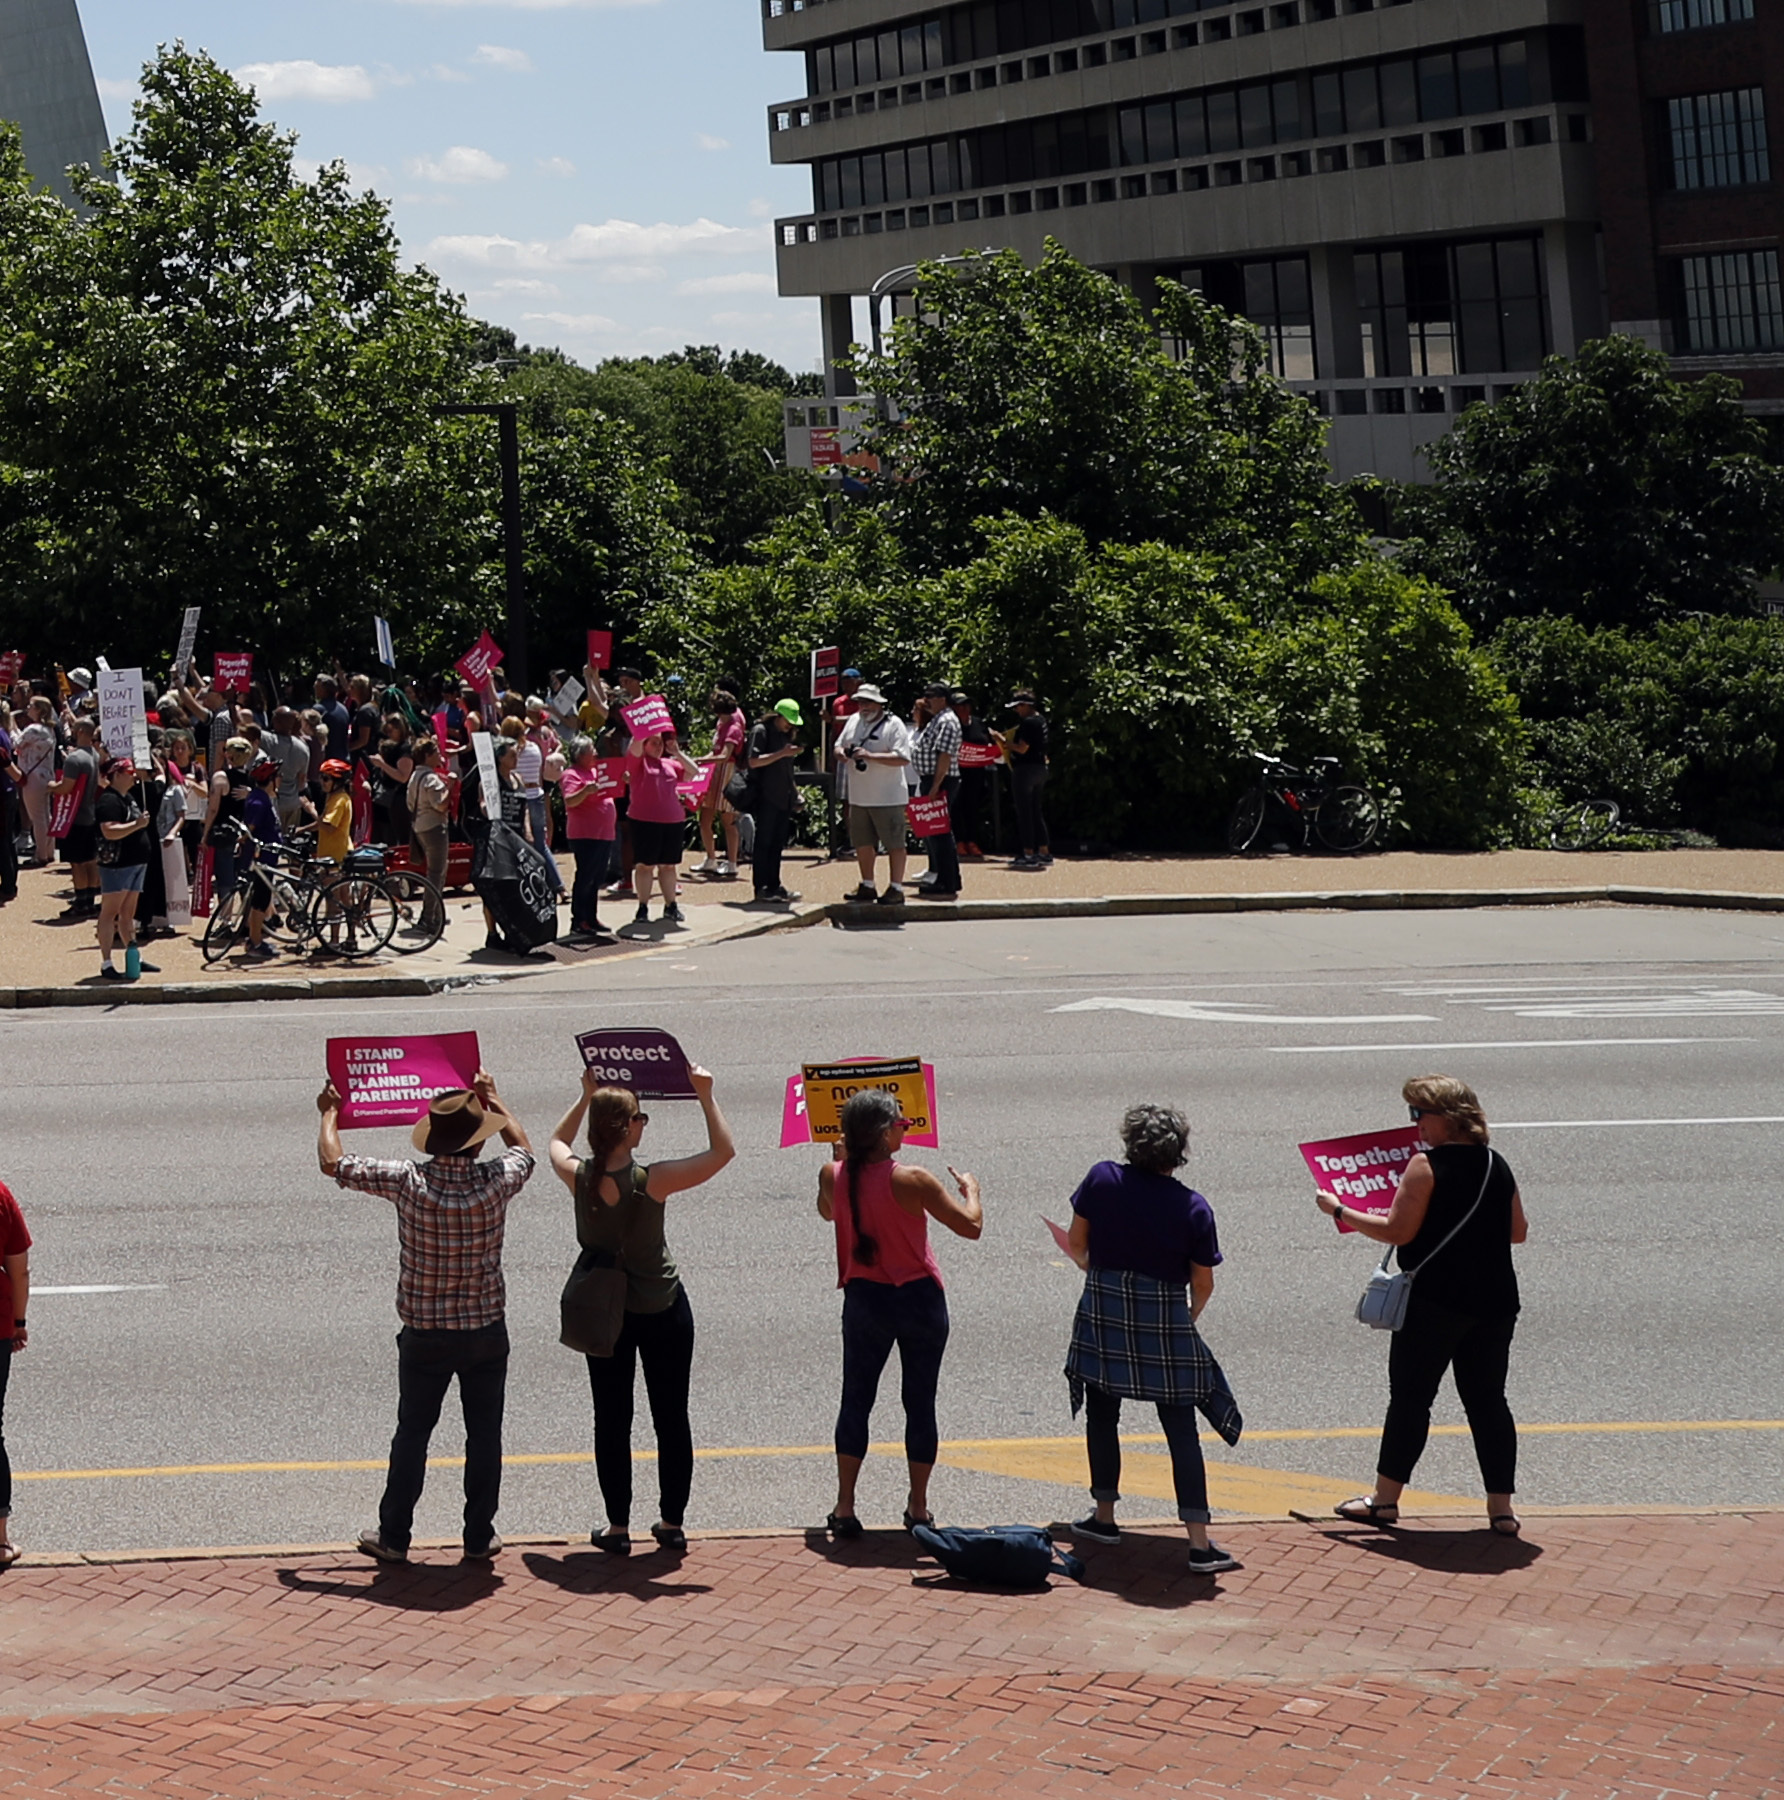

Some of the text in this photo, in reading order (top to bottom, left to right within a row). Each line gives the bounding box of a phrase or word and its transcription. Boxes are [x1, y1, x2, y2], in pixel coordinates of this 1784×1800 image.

[102, 705, 136, 719] REGRET
[633, 711, 658, 726] Fight
[111, 724, 127, 735] MY
[915, 808, 940, 822] Fight
[346, 1047, 404, 1061] I STAND
[584, 1043, 671, 1064] Protect
[347, 1062, 389, 1075] WITH
[592, 1064, 632, 1082] Roe
[348, 1074, 421, 1090] PLANNED
[358, 1106, 418, 1117] Planned Parenthood
[1314, 1145, 1412, 1174] Together
[1331, 1174, 1388, 1198] Fight
